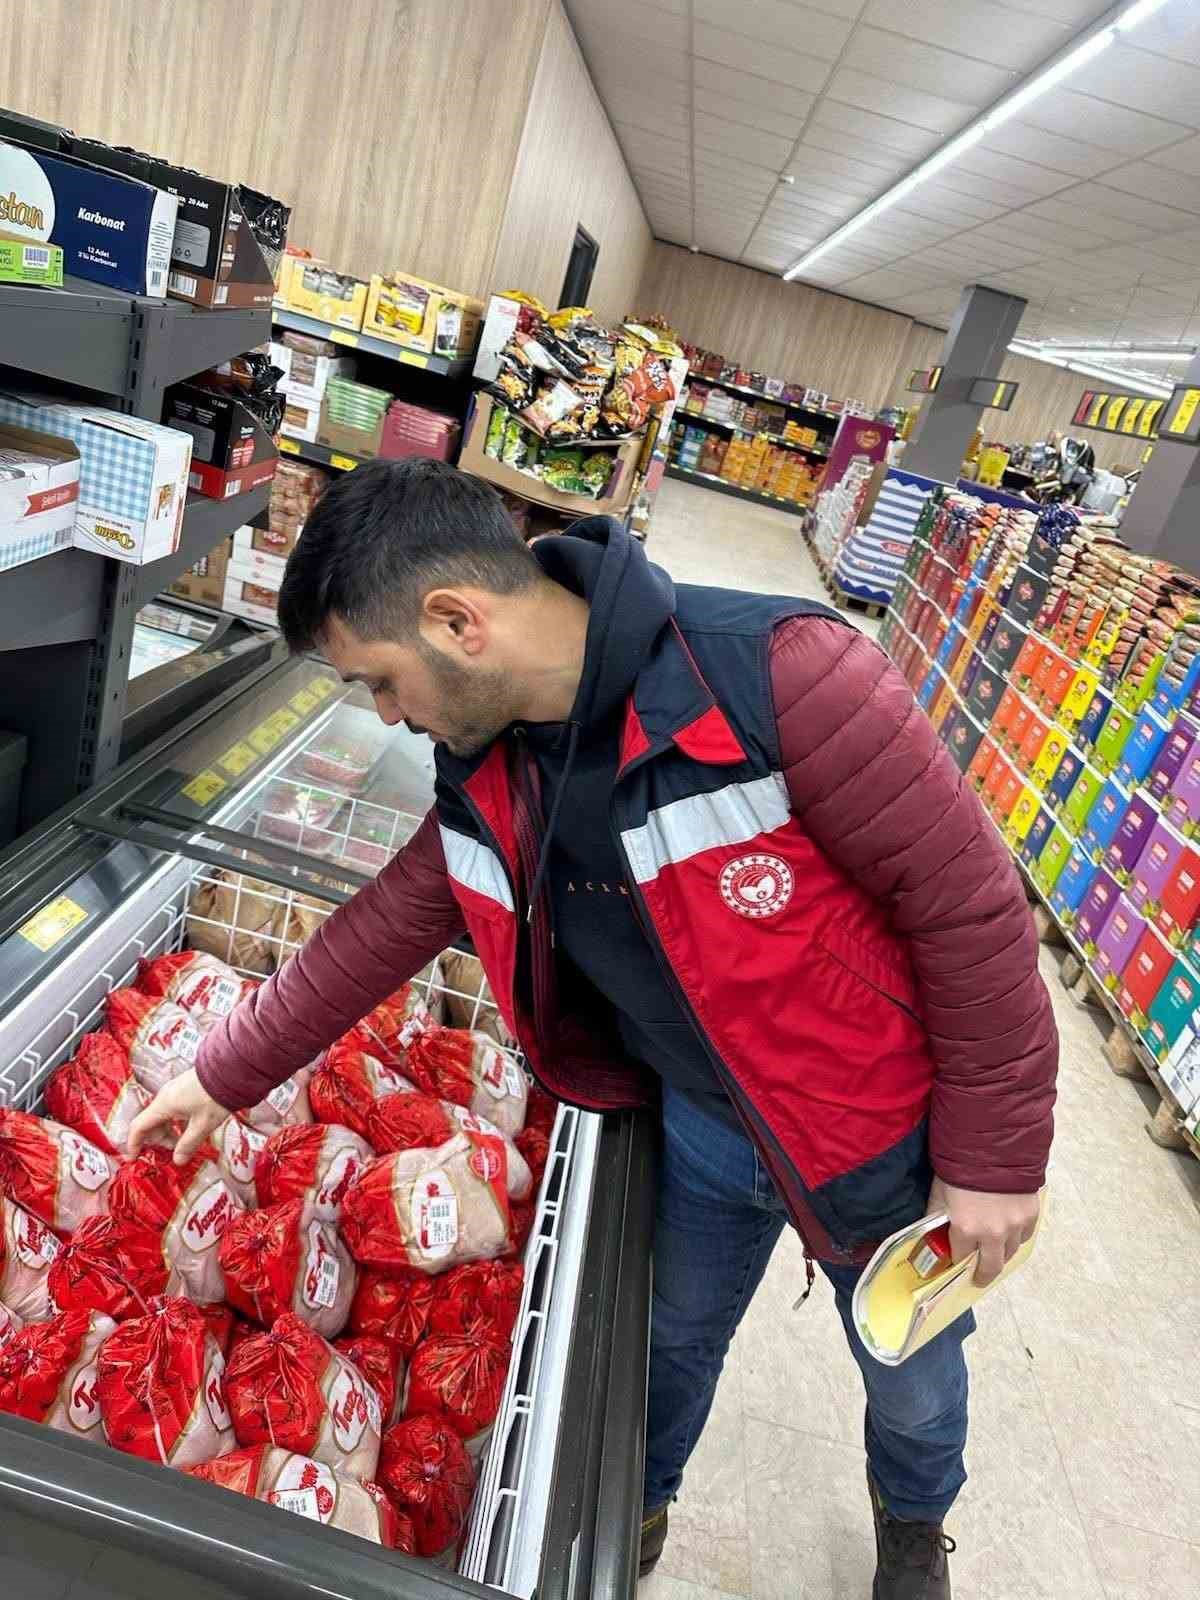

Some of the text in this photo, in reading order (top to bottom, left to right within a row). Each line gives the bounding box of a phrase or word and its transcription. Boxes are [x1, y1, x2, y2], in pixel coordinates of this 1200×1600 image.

[77, 207, 126, 232] Karbonat
[89, 255, 118, 269] Karbonat
[187, 1192, 229, 1239] Tazem
